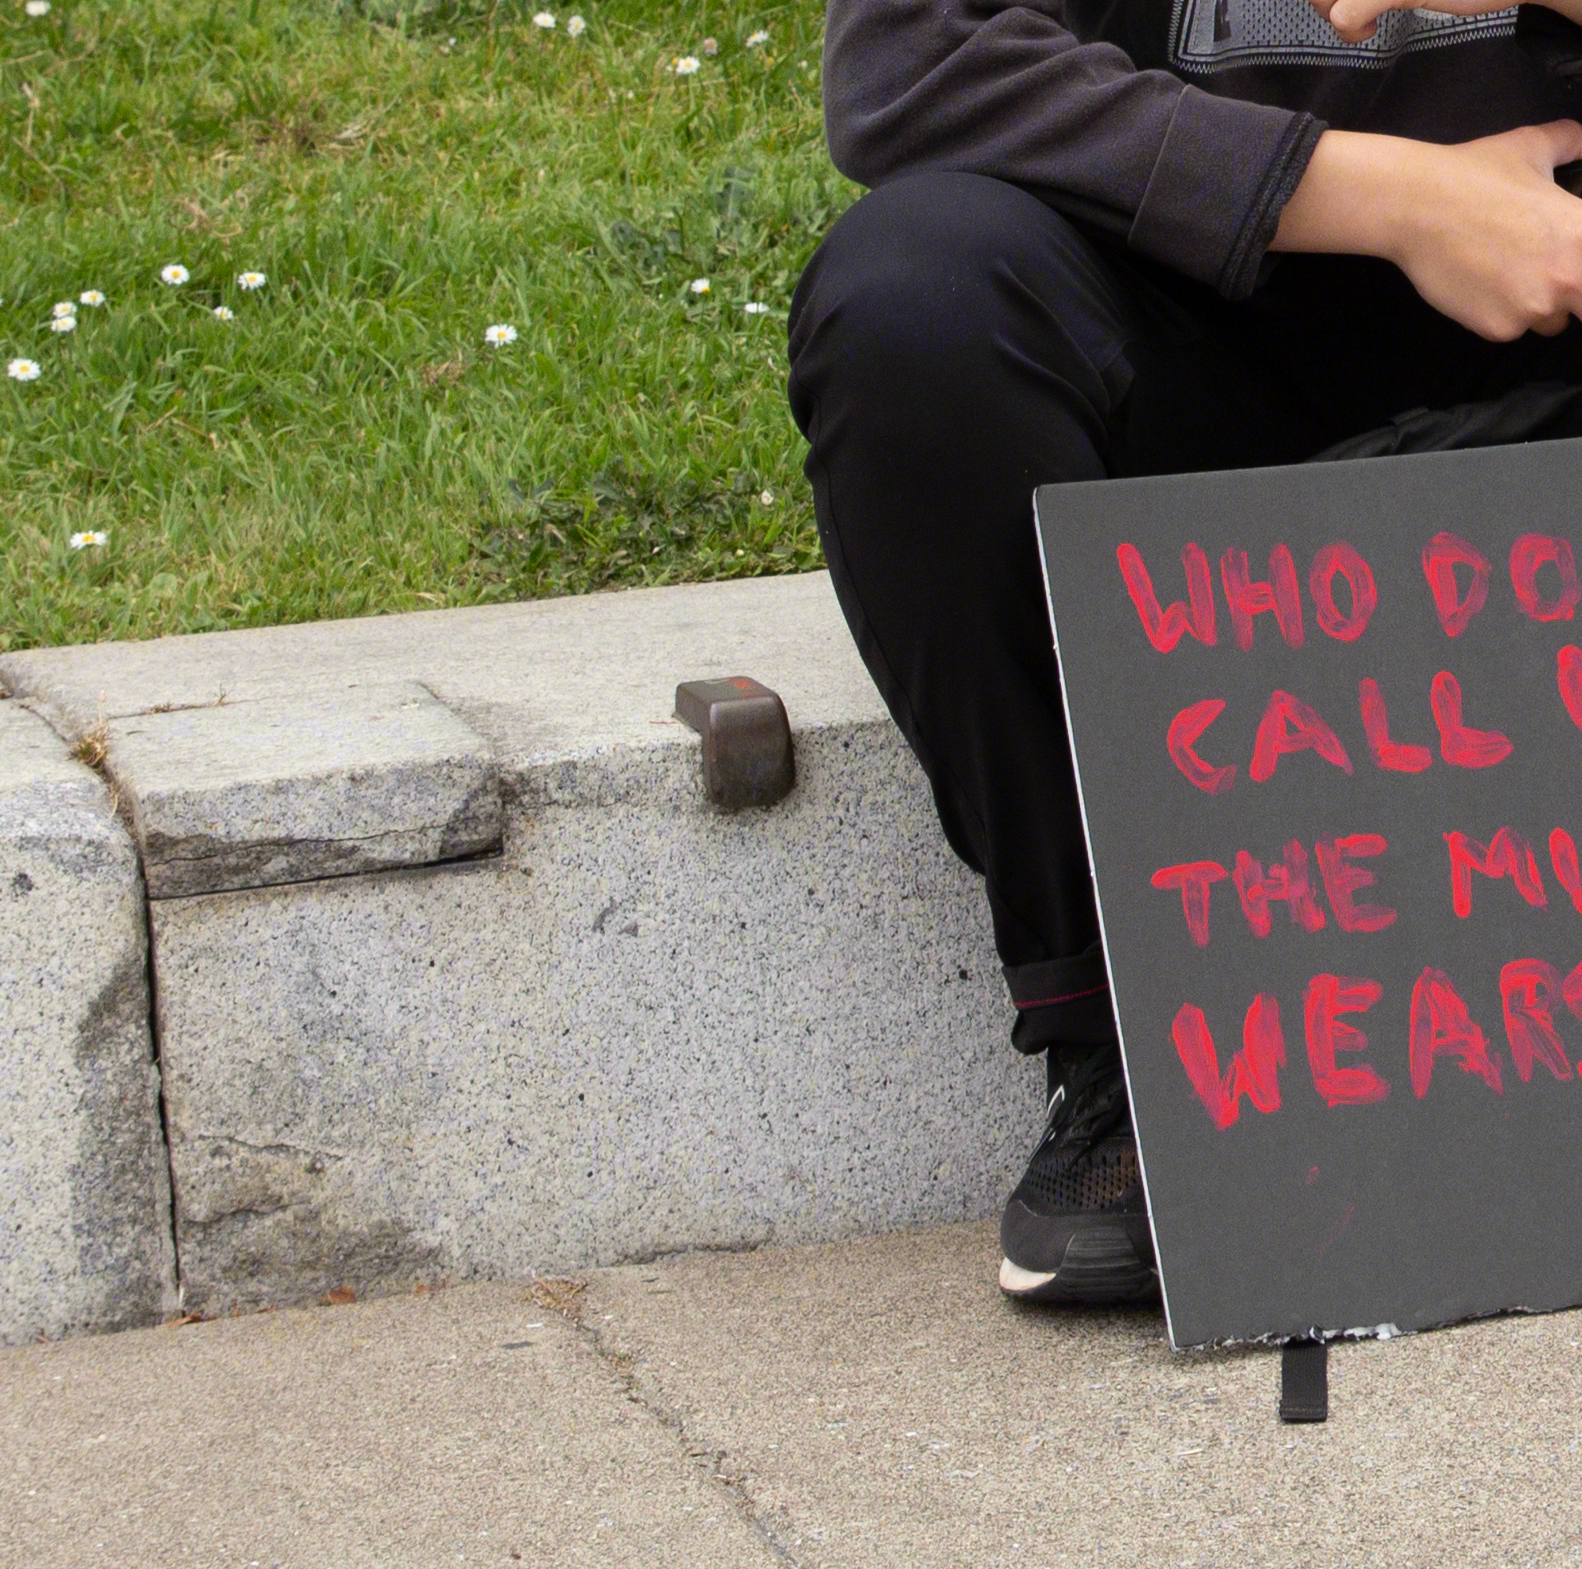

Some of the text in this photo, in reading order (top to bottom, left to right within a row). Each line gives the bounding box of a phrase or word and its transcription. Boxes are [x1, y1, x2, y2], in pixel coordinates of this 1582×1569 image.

[1116, 541, 1379, 654] WHO
[1421, 531, 1582, 637] DO
[1166, 670, 1514, 794] CALL
[1150, 833, 1397, 946] THE
